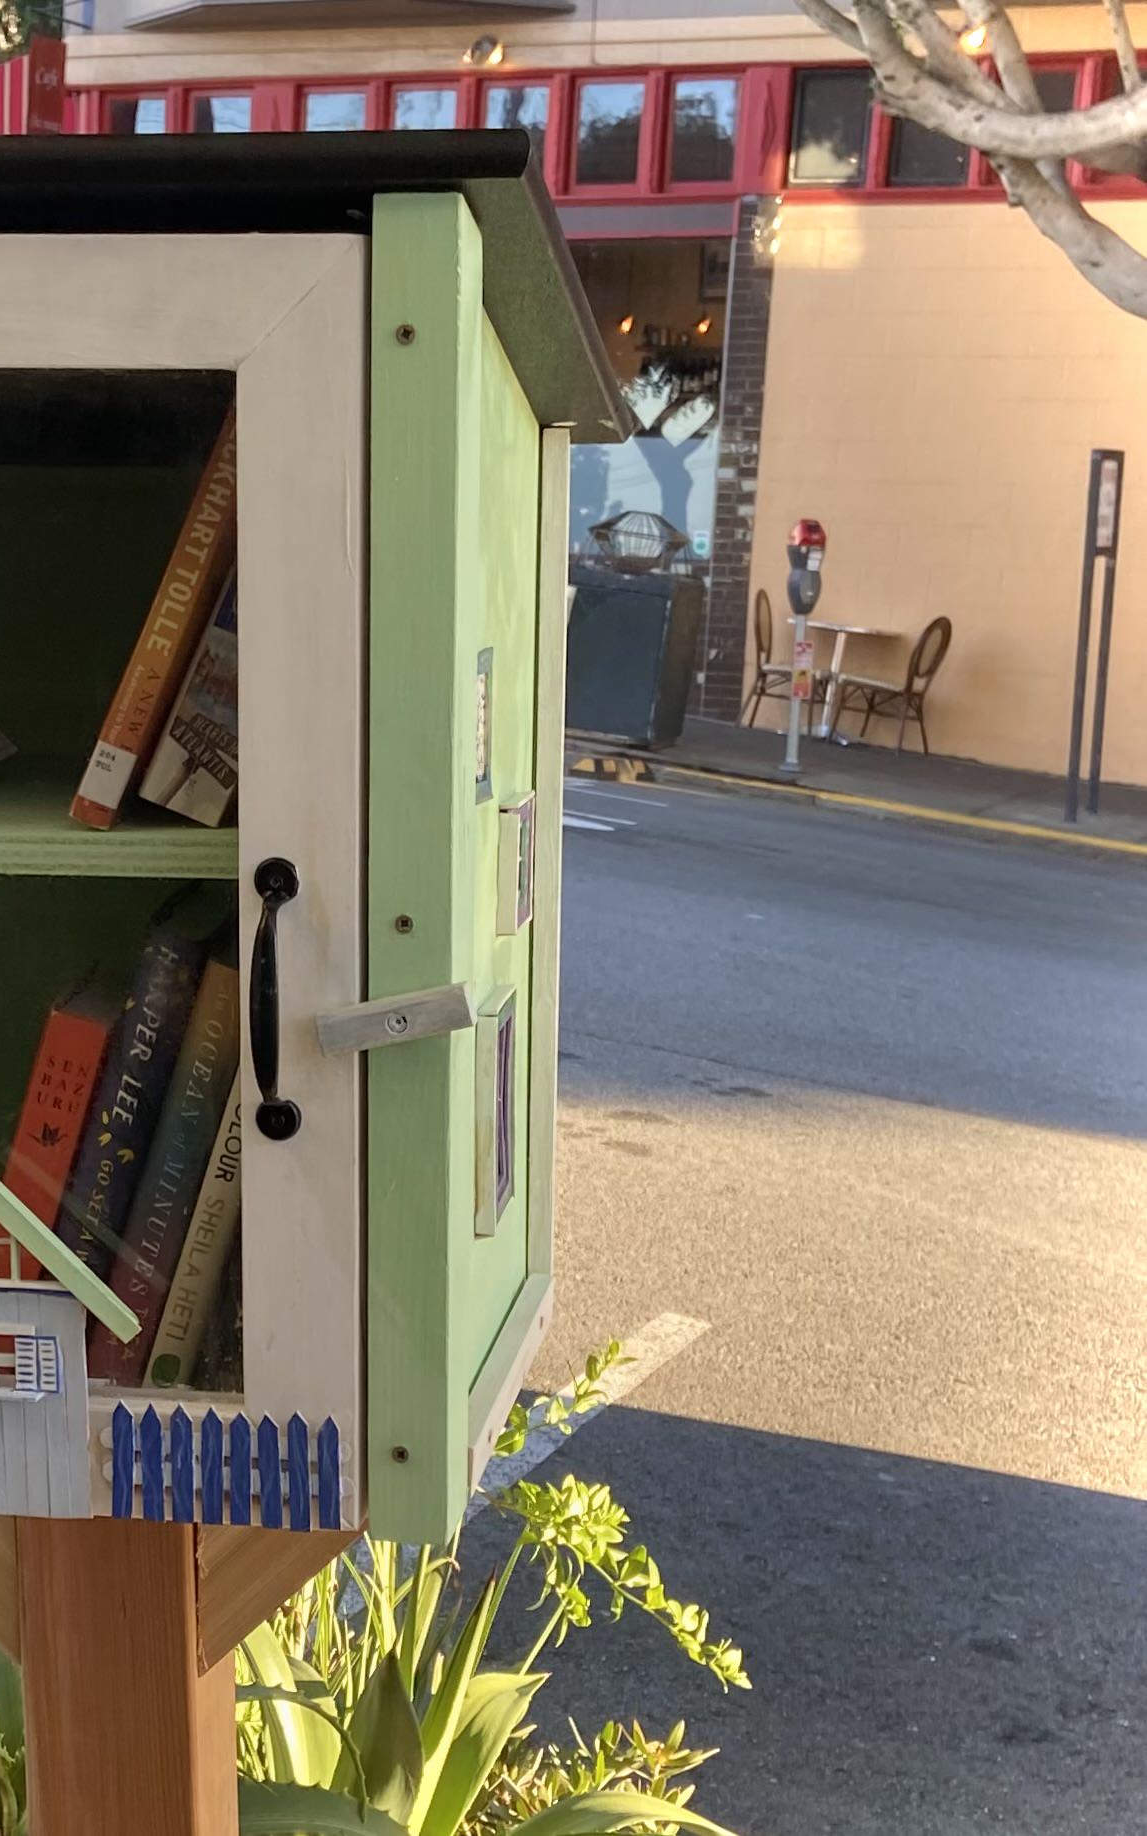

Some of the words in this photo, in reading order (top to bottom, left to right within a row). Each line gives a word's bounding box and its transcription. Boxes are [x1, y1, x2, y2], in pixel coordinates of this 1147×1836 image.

[147, 566, 200, 657] TOLLE
[147, 667, 161, 682] A
[128, 689, 155, 732] NEW
[174, 726, 230, 781] ATLANTIS
[40, 1072, 84, 1096] BAZ
[112, 1073, 142, 1127] LEE
[181, 1019, 224, 1128] OCEAN
[98, 1159, 114, 1186] GO
[86, 1189, 105, 1227] SET
[129, 1152, 183, 1297] MINUTES
[186, 1197, 224, 1278] SHEILA
[167, 1286, 195, 1341] HETI
